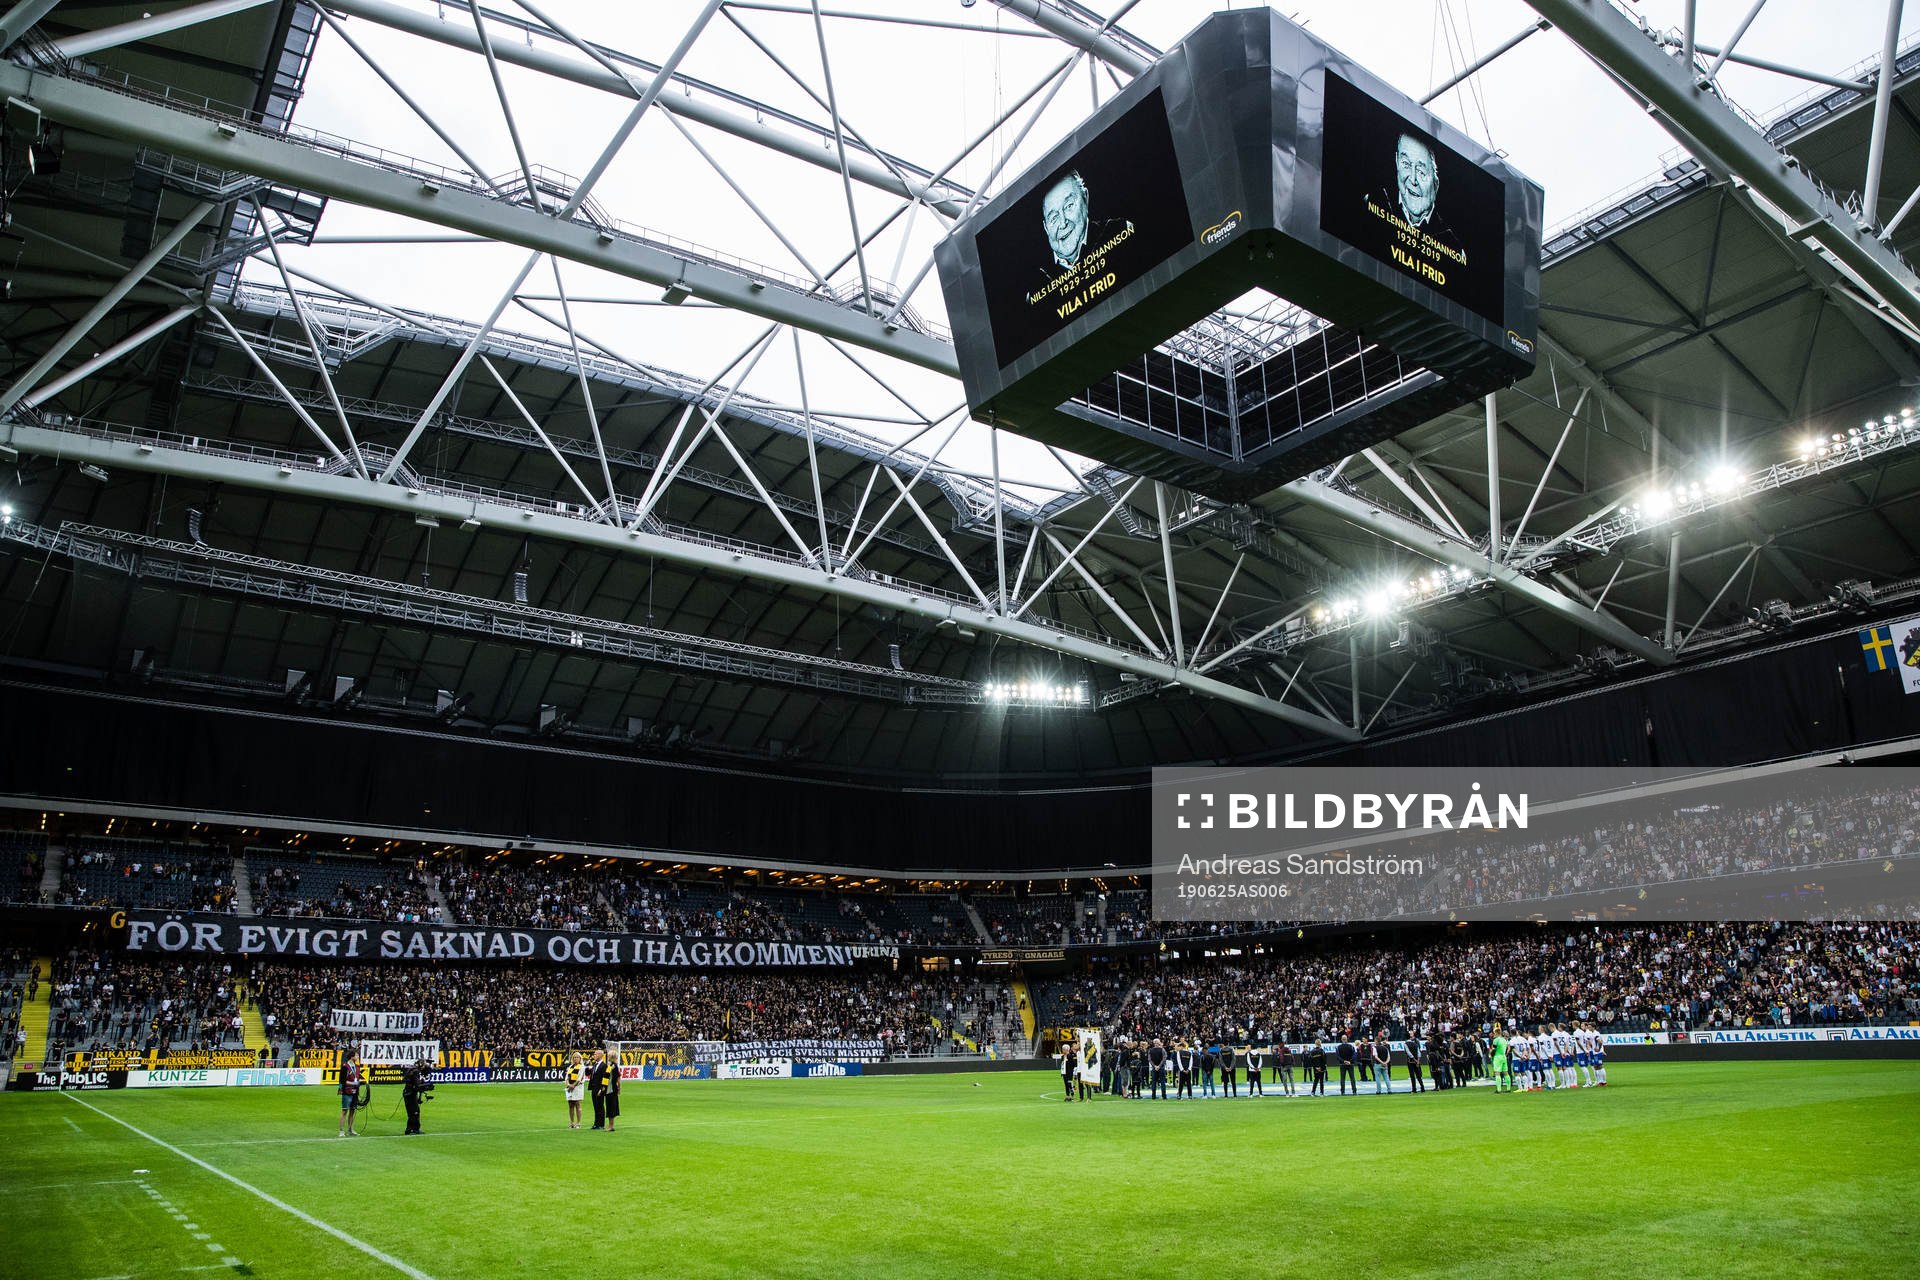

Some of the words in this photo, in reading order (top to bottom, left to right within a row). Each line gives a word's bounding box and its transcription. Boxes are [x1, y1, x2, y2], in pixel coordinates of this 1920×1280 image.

[1207, 220, 1237, 244] friends
[1368, 201, 1385, 219] NILS
[1386, 212, 1420, 239] LENNART
[1421, 233, 1466, 267] JOHANNSON
[1397, 230, 1440, 262] 1929-2019
[1030, 287, 1047, 305] NILS
[1047, 262, 1082, 293] LENNART
[1083, 225, 1135, 268] JOHANNSON
[1391, 244, 1415, 270] VILA
[1422, 262, 1446, 286] FRID
[1060, 258, 1106, 296] 1929-2019
[1057, 296, 1083, 319] VILA
[1089, 272, 1116, 299] FRID
[126, 914, 224, 951] FÖR
[238, 926, 368, 957] EVIGT
[380, 930, 535, 959] SAKNAD
[547, 935, 621, 964] OCH
[631, 934, 854, 967] IHÅGKOMMEN!
[330, 1012, 367, 1028] VILA
[373, 1014, 379, 1028] I
[385, 1015, 419, 1029] FRID
[362, 1043, 436, 1060] LENNART
[765, 1039, 819, 1049] LENNART
[148, 1070, 208, 1082] KUNTZE
[235, 1069, 306, 1086] Flinks
[491, 1066, 540, 1080] JÄRFÄLLA
[739, 1066, 780, 1076] TEKNOS
[808, 1063, 846, 1077] LLENTAB
[35, 1072, 57, 1086] The
